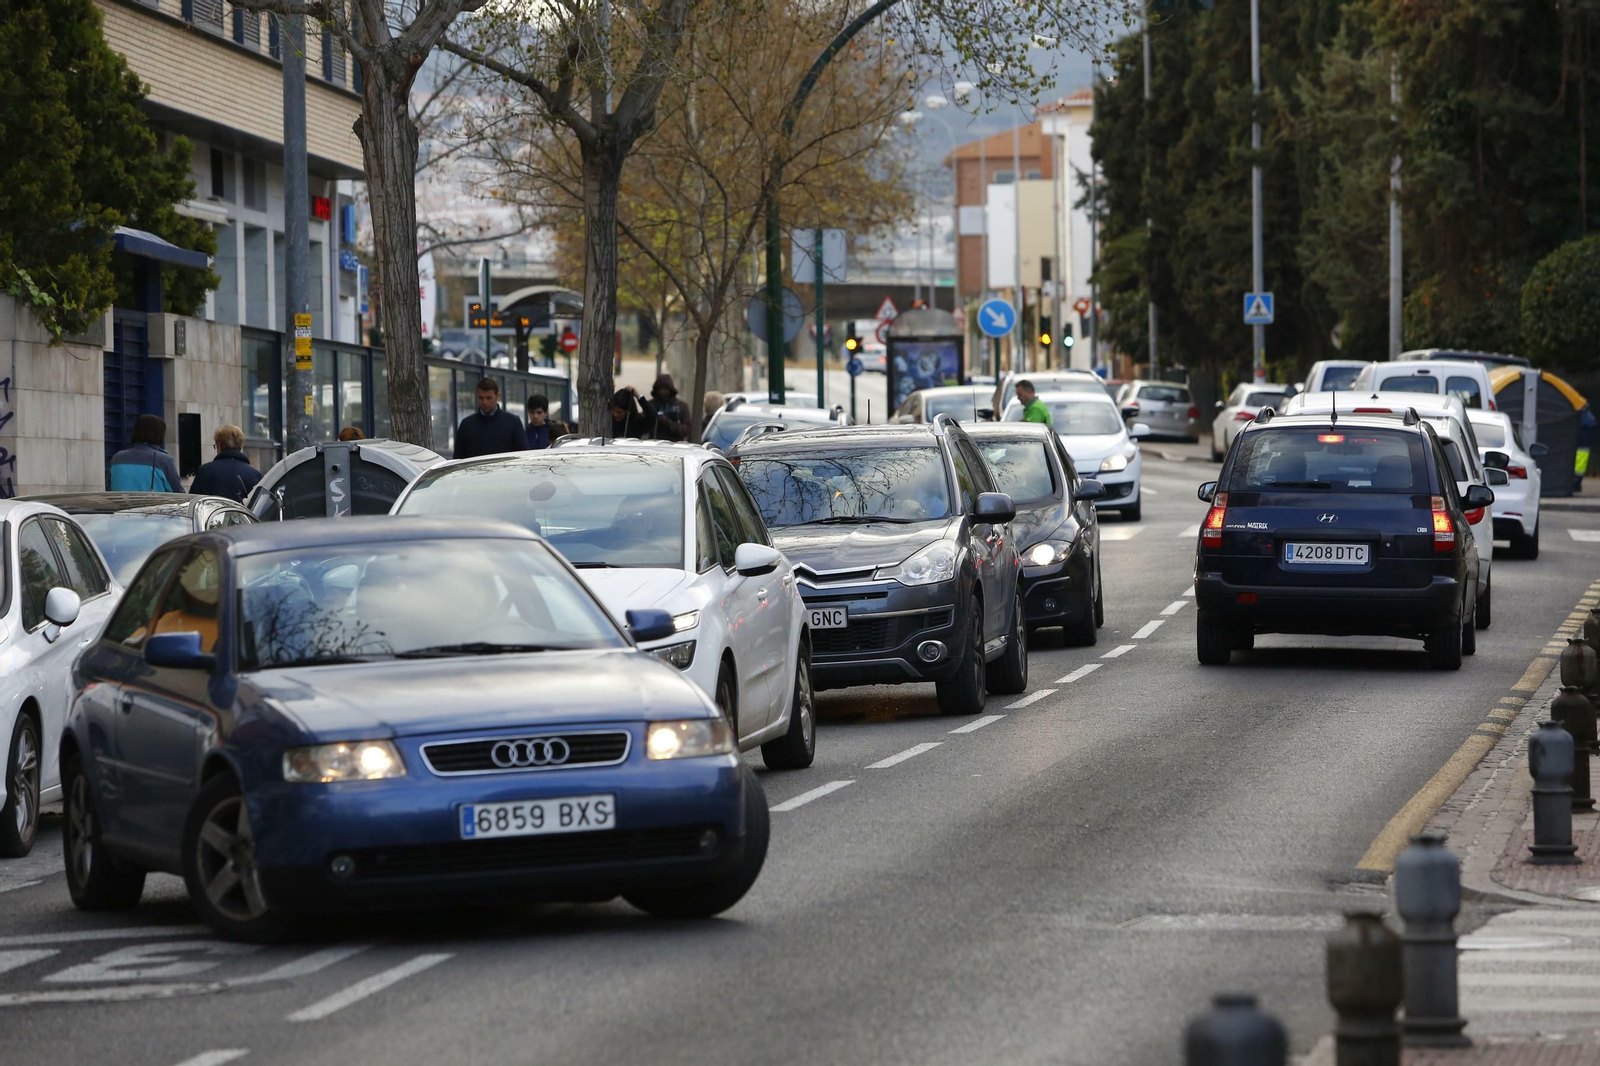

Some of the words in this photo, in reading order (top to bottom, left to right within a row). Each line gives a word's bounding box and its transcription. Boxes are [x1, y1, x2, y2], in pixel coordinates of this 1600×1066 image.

[1295, 546, 1333, 559] 4208
[1336, 546, 1364, 560] DTC
[811, 610, 843, 626] GNC
[476, 805, 545, 833] 6859
[559, 801, 609, 827] BXS
